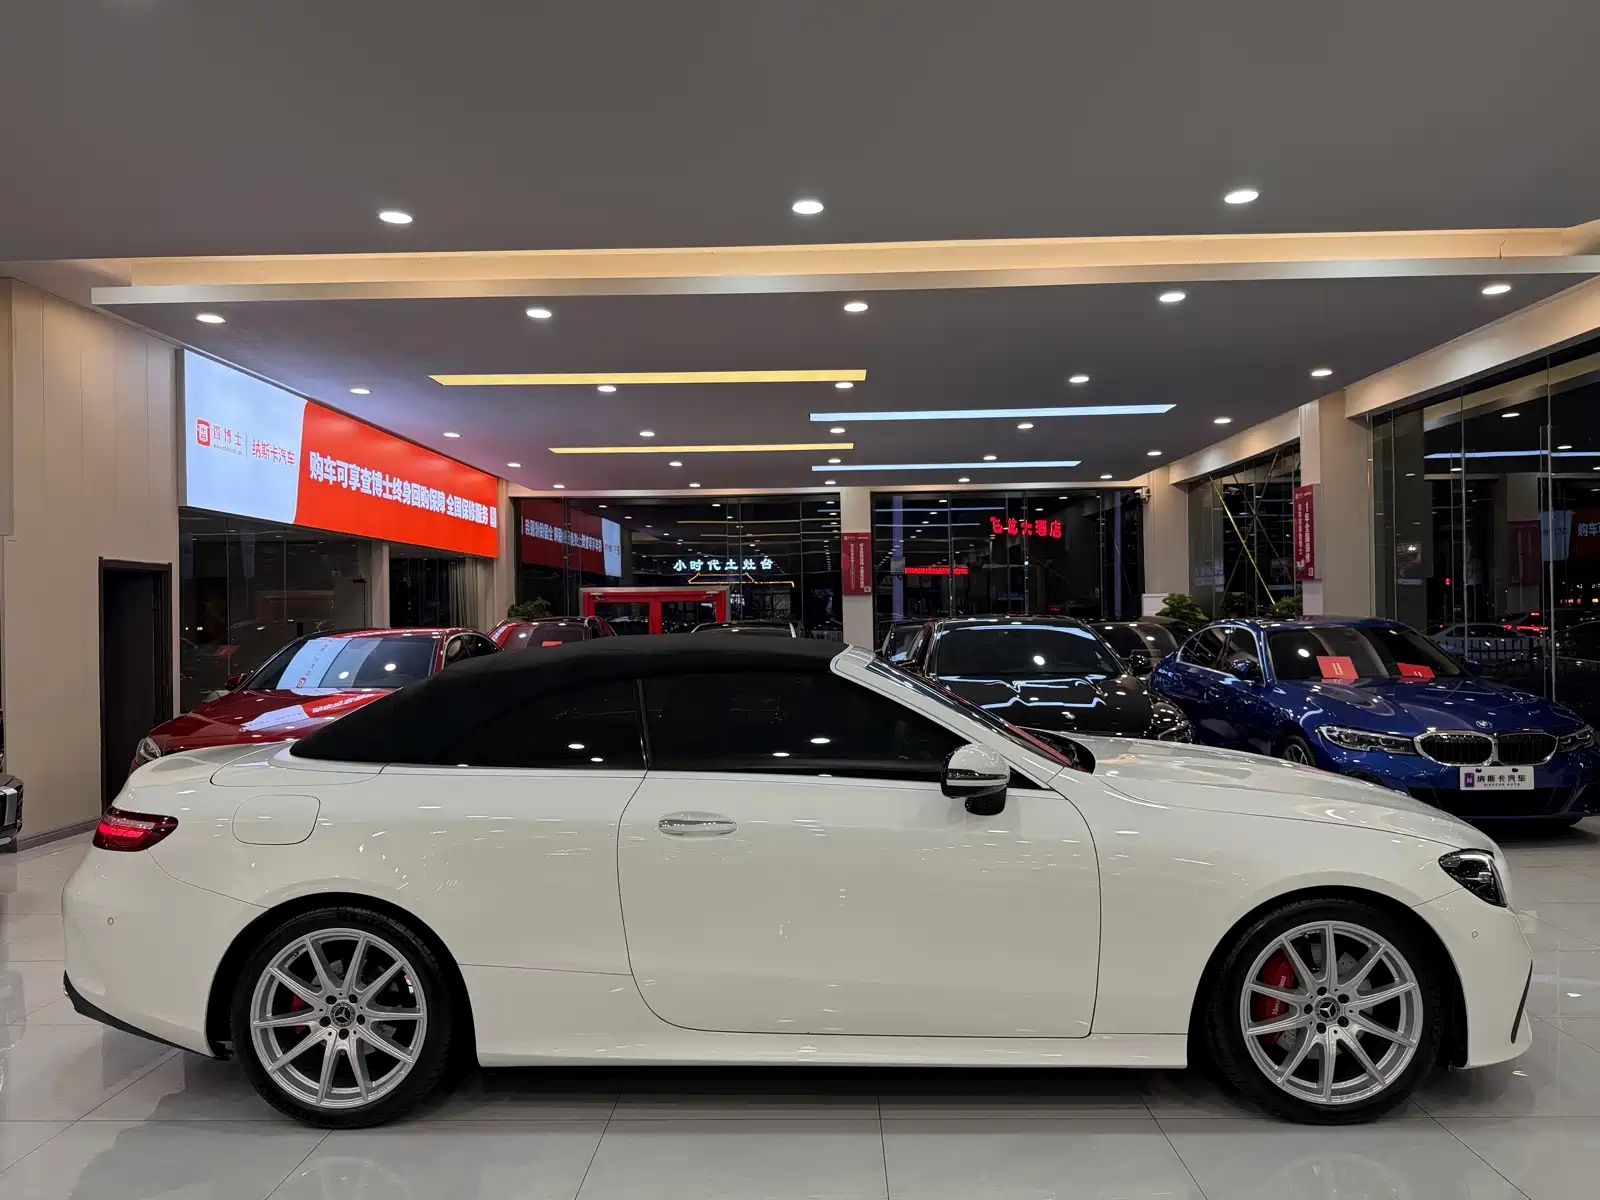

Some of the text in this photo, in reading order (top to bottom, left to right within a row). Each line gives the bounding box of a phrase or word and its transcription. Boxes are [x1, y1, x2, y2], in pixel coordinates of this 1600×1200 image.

[252, 439, 295, 467] 纳斯卡汽车
[309, 451, 446, 514] 购车可享查博士终身回购保障
[446, 493, 489, 526] 全国保修服务
[673, 558, 774, 571] 小时代土灶台
